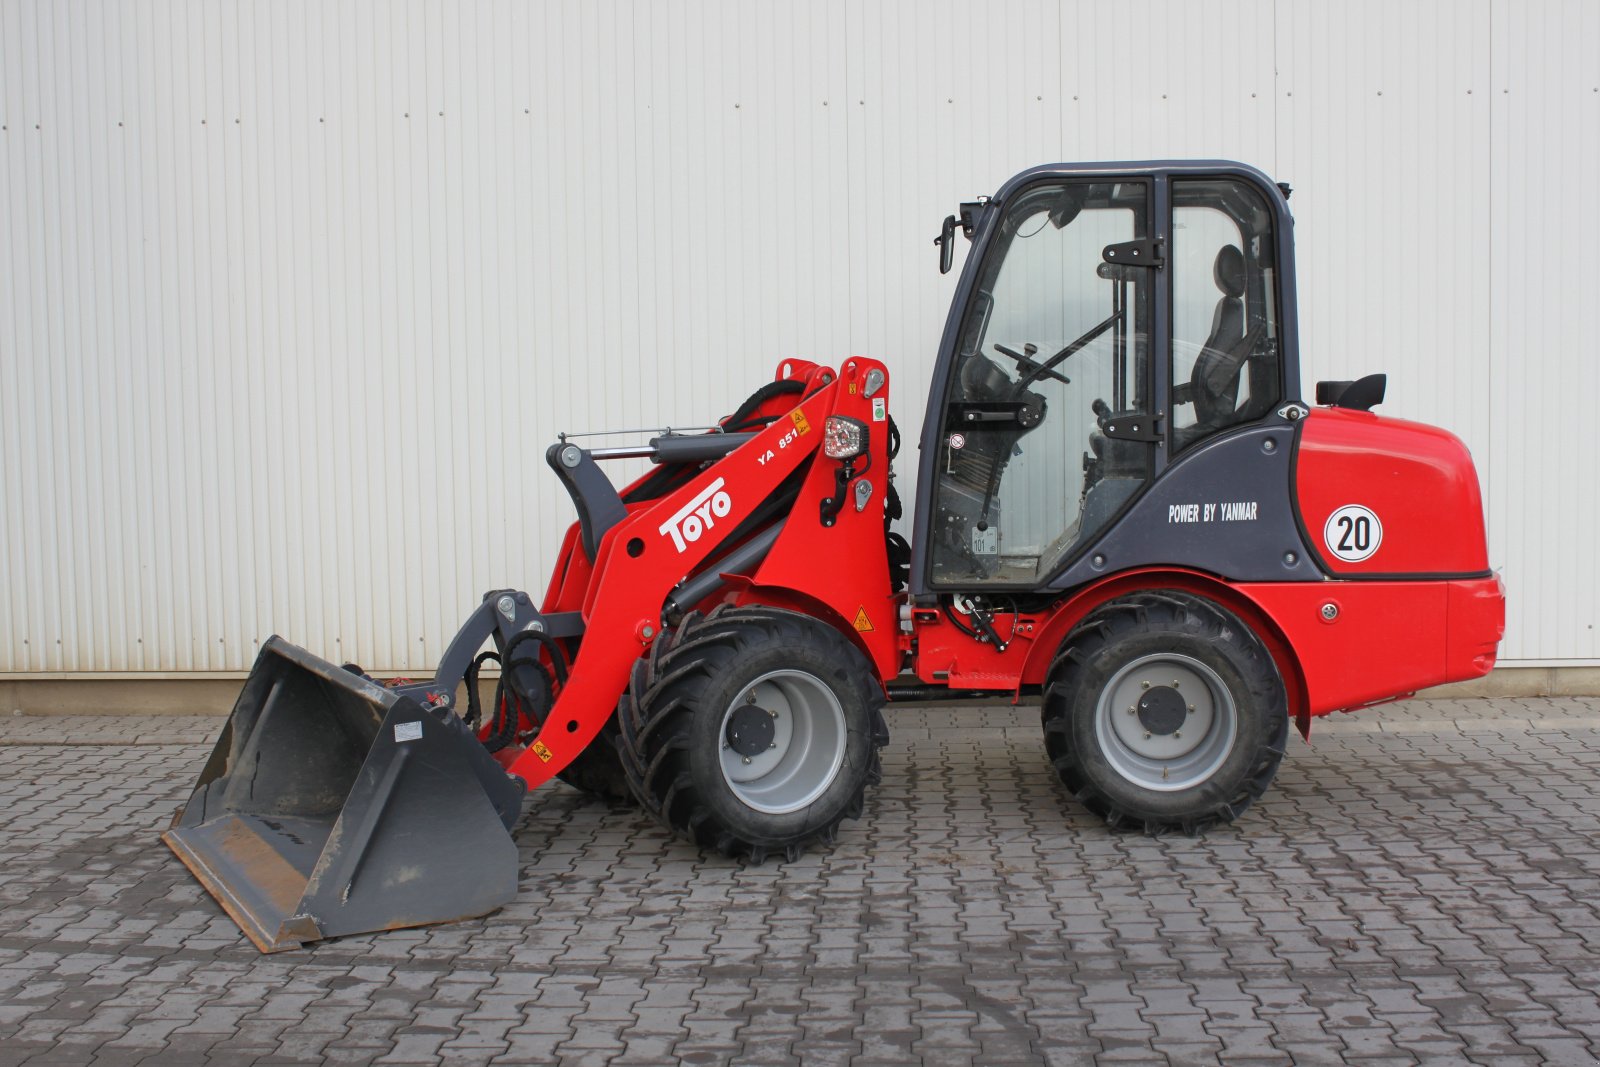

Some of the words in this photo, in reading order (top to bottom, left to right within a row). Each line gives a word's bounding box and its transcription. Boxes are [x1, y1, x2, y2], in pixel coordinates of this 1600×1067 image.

[757, 450, 775, 466] YA
[778, 427, 799, 450] 851
[659, 477, 731, 553] TOYO
[1168, 503, 1200, 524] POWER
[1203, 502, 1216, 522] BY
[1220, 501, 1258, 522] YANMAR
[974, 539, 984, 552] 101
[1337, 515, 1371, 552] 20
